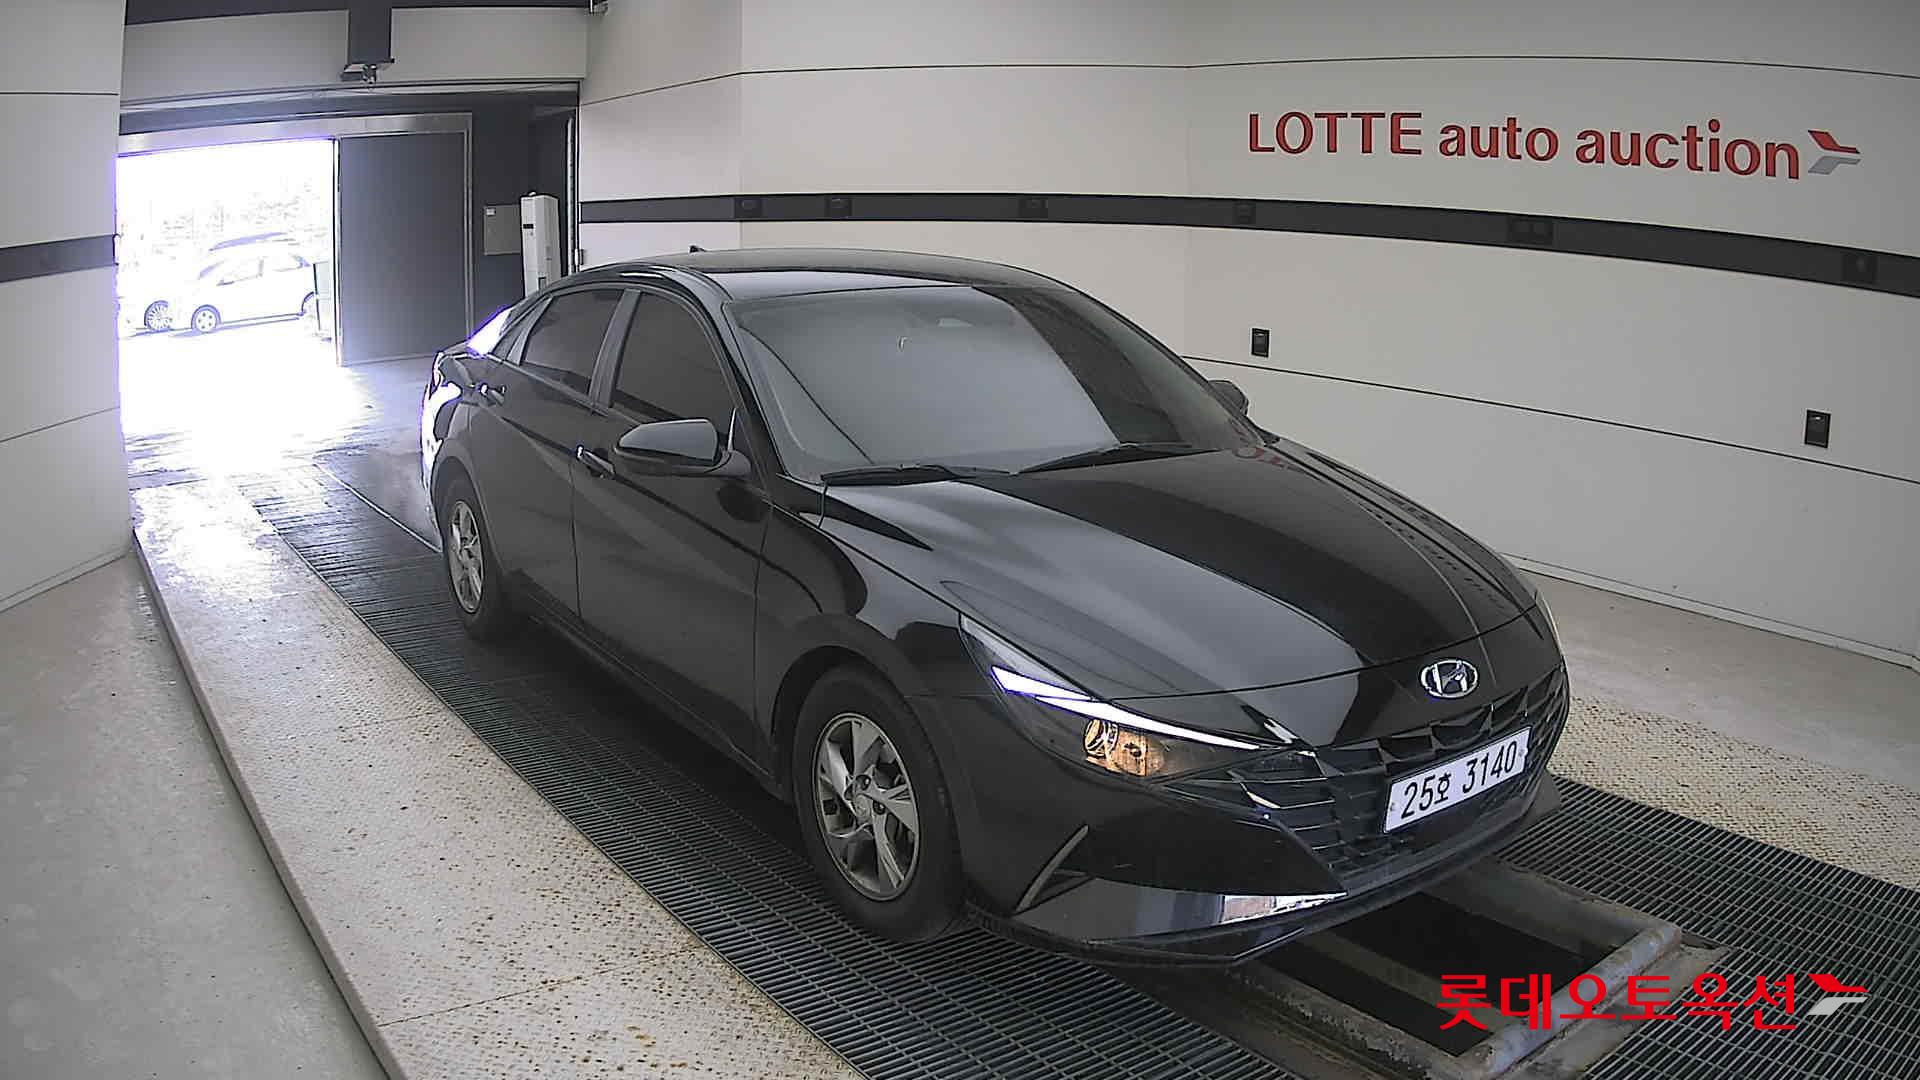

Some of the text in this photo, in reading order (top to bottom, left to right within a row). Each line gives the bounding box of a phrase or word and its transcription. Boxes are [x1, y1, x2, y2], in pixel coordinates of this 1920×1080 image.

[1248, 110, 1801, 180] LOTTE auto auction
[1400, 740, 1518, 820] 25호 3140
